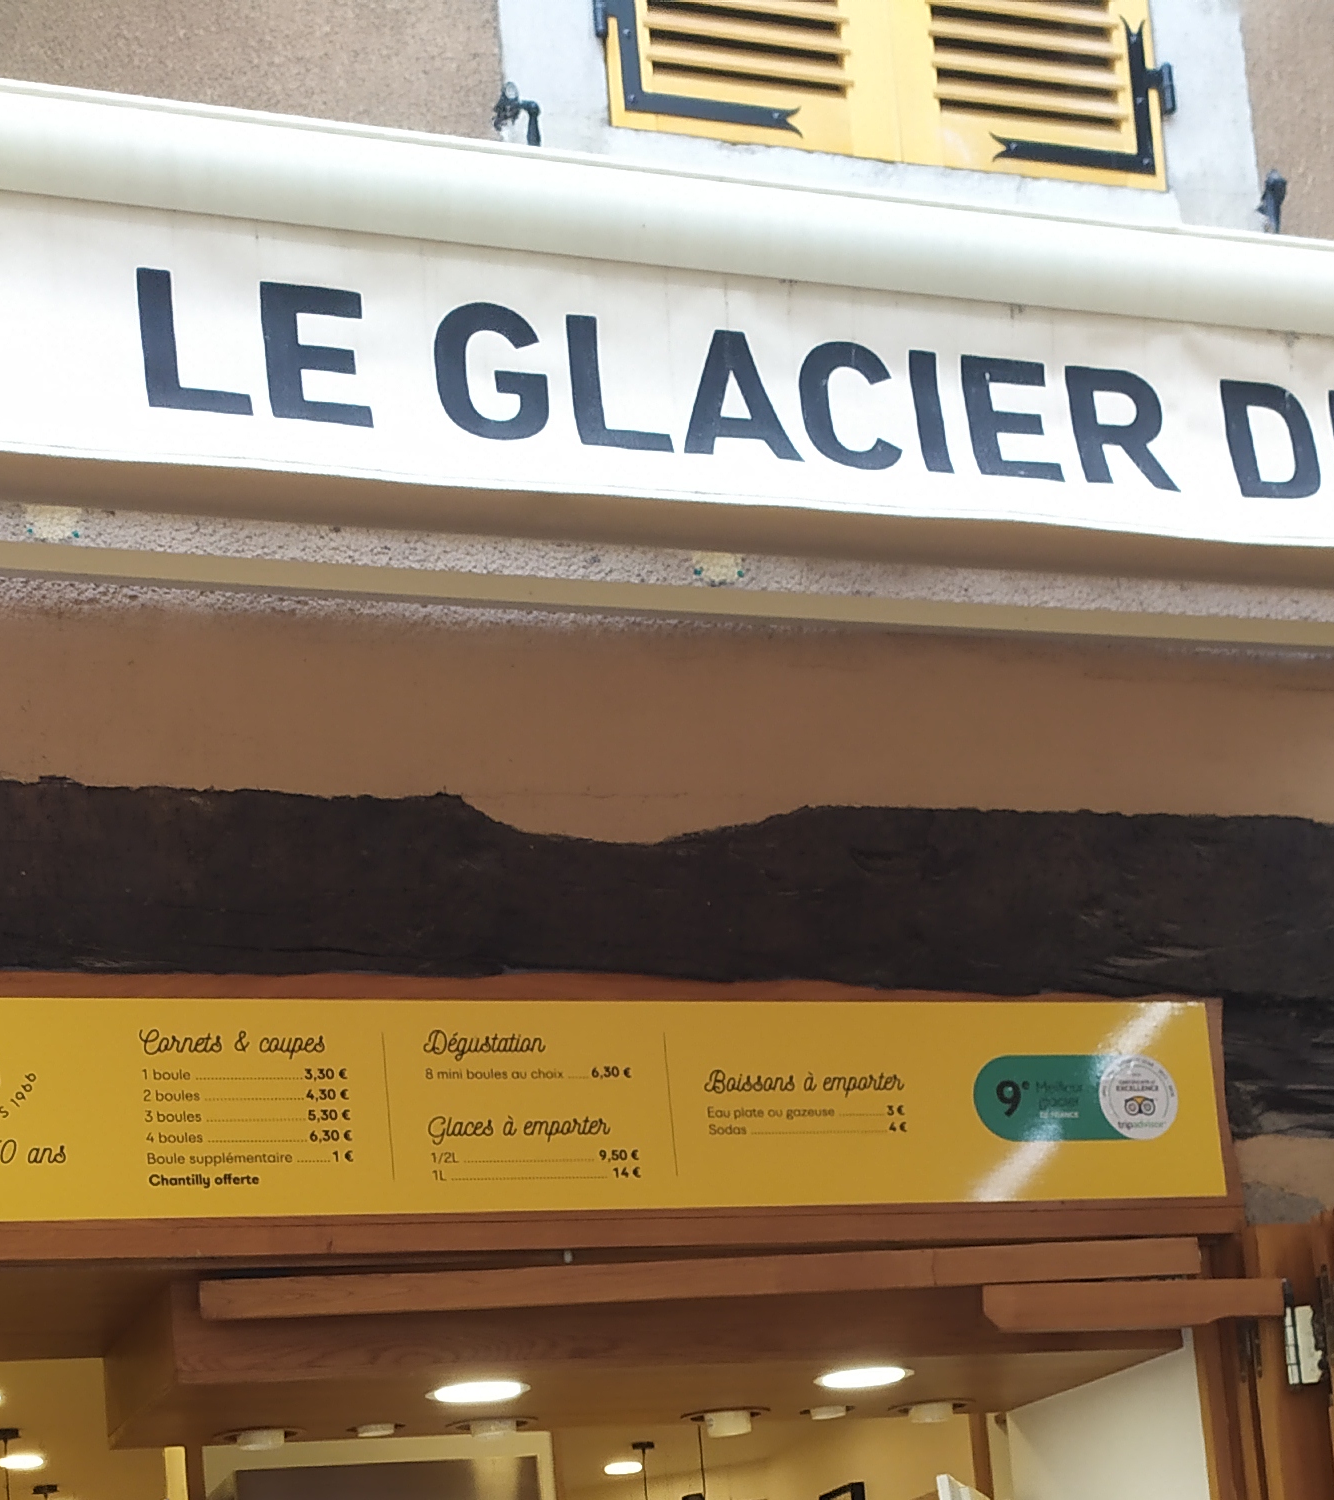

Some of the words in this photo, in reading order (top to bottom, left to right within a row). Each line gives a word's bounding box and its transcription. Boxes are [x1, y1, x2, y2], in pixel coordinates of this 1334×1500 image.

[136, 267, 374, 428] LE
[434, 302, 1180, 491] GLACIER
[139, 1029, 222, 1055] Cornets
[234, 1031, 249, 1052] &
[260, 1036, 325, 1059] coupes
[424, 1030, 546, 1061] Dégustation
[142, 1069, 148, 1080] 1
[153, 1069, 190, 1080] boule
[305, 1068, 334, 1081] 3,30
[339, 1069, 347, 1079] €
[426, 1068, 433, 1079] 8
[437, 1071, 462, 1079] mini
[467, 1069, 507, 1079] boules
[511, 1071, 527, 1079] au
[531, 1069, 563, 1079] choix
[592, 1066, 619, 1078] 6,30
[624, 1068, 631, 1078] €
[704, 1070, 795, 1094] Boissons
[804, 1072, 817, 1091] à
[823, 1073, 904, 1097] emporter
[144, 1089, 151, 1101] 2
[156, 1090, 200, 1101] boules
[306, 1089, 336, 1101] 4,30
[340, 1089, 349, 1099] €
[145, 1110, 153, 1122] 3
[157, 1111, 201, 1122] boules
[308, 1110, 337, 1122] 5,30
[342, 1110, 350, 1120] €
[707, 1106, 730, 1118] Eau
[734, 1108, 764, 1119] plate
[768, 1109, 783, 1117] ou
[786, 1109, 834, 1120] gazeuse
[887, 1105, 894, 1116] 3
[428, 1116, 493, 1145] Glaces
[503, 1116, 517, 1136] à
[524, 1117, 610, 1142] emporter
[709, 1124, 746, 1135] Sodas
[889, 1122, 896, 1131] 4
[1117, 1120, 1164, 1130] tripadvisor
[146, 1132, 154, 1143] 4
[159, 1132, 203, 1143] boules
[310, 1130, 339, 1142] 6,30
[344, 1130, 352, 1141] €
[28, 1145, 66, 1163] ans
[147, 1153, 185, 1164] Boule
[190, 1153, 292, 1166] supplémentaire
[332, 1151, 339, 1162] 1
[345, 1151, 353, 1162] €
[432, 1152, 459, 1163] 1/2L
[599, 1150, 627, 1162] 9,50
[631, 1150, 638, 1160] €
[149, 1174, 210, 1188] Chantilly
[215, 1174, 259, 1185] offerte
[433, 1170, 446, 1181] 1L
[613, 1167, 628, 1178] 14
[633, 1167, 640, 1178] €
